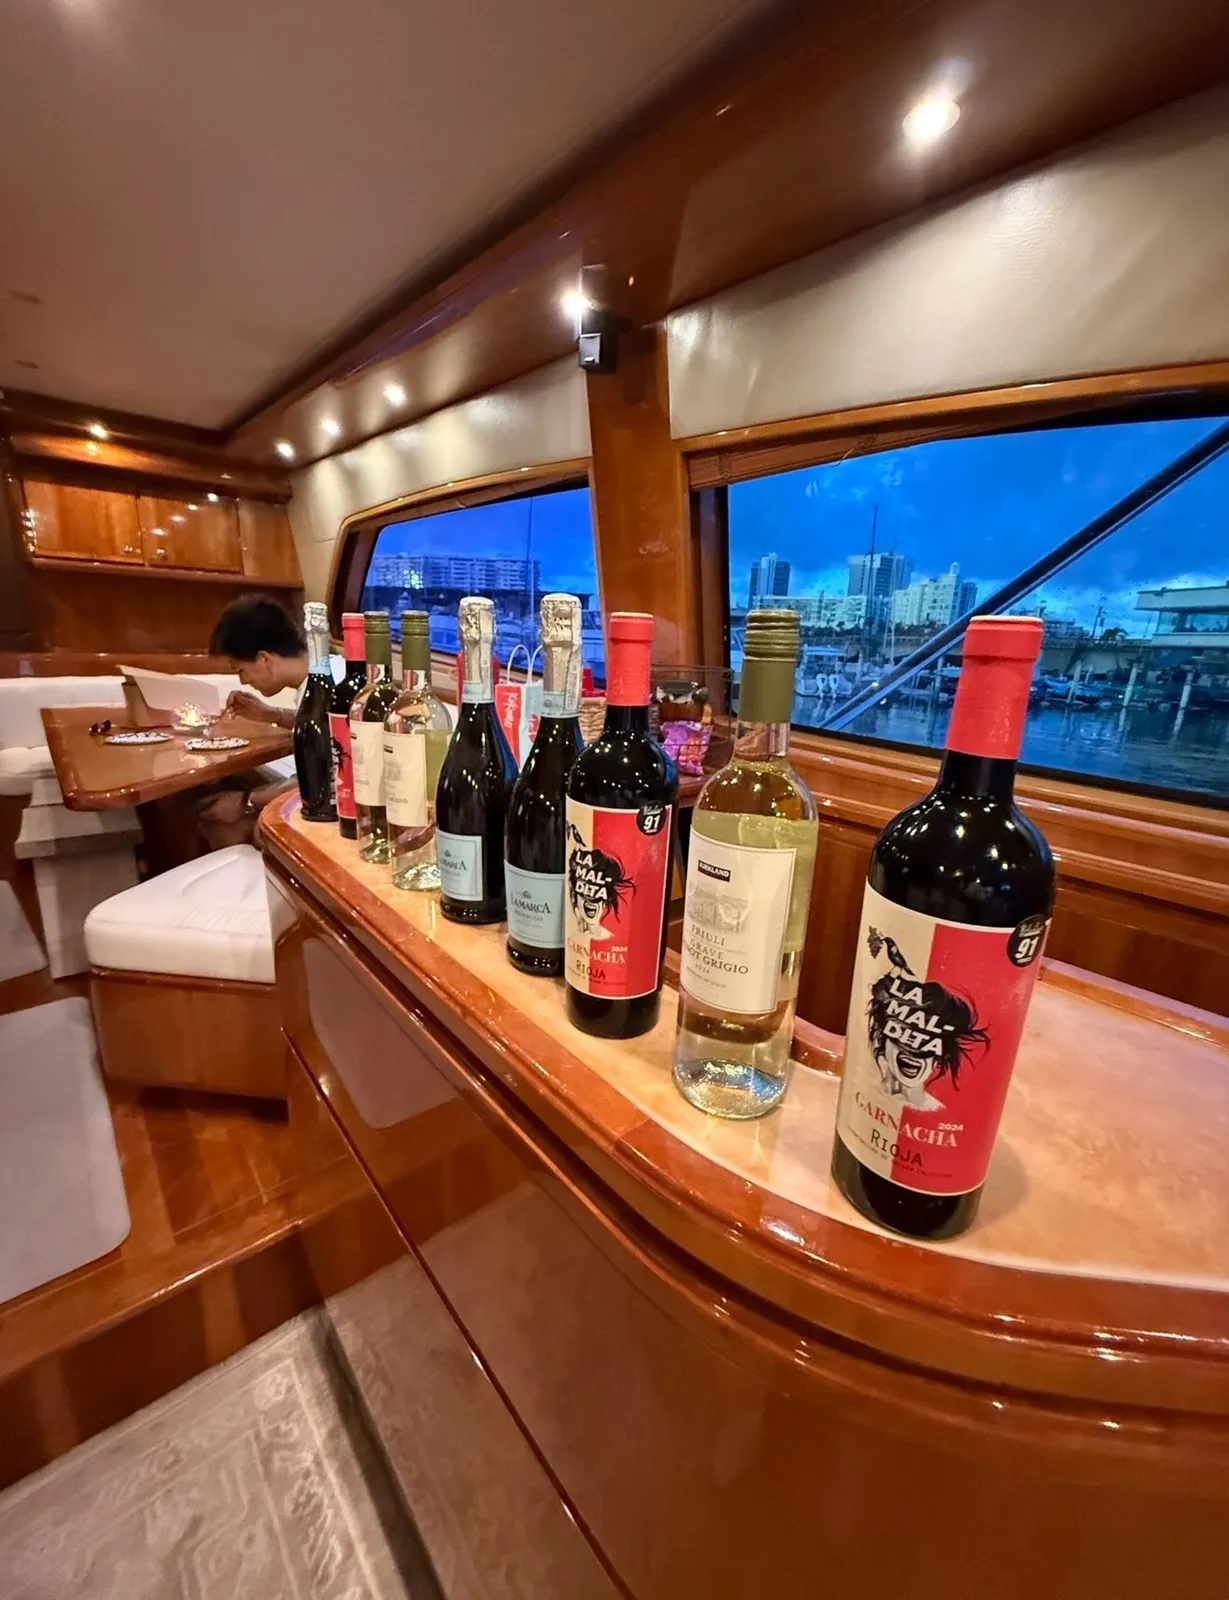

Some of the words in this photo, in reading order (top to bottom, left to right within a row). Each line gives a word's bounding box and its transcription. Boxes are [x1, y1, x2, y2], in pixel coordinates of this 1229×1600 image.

[643, 815, 660, 830] 91
[575, 851, 593, 868] LA
[575, 865, 613, 885] MAL-
[575, 880, 608, 900] DITA
[691, 924, 725, 946] FRIULI
[690, 939, 724, 961] GRAVE
[1014, 936, 1039, 959] 91
[576, 959, 606, 980] RIOJA
[702, 955, 749, 975] GRIGIO
[889, 978, 923, 1006] LA
[886, 999, 955, 1034] MAL-
[883, 1020, 942, 1056] DITA
[855, 1091, 958, 1148] GARNACHA
[937, 1122, 964, 1132] 2024
[870, 1128, 923, 1168] RIOJA
